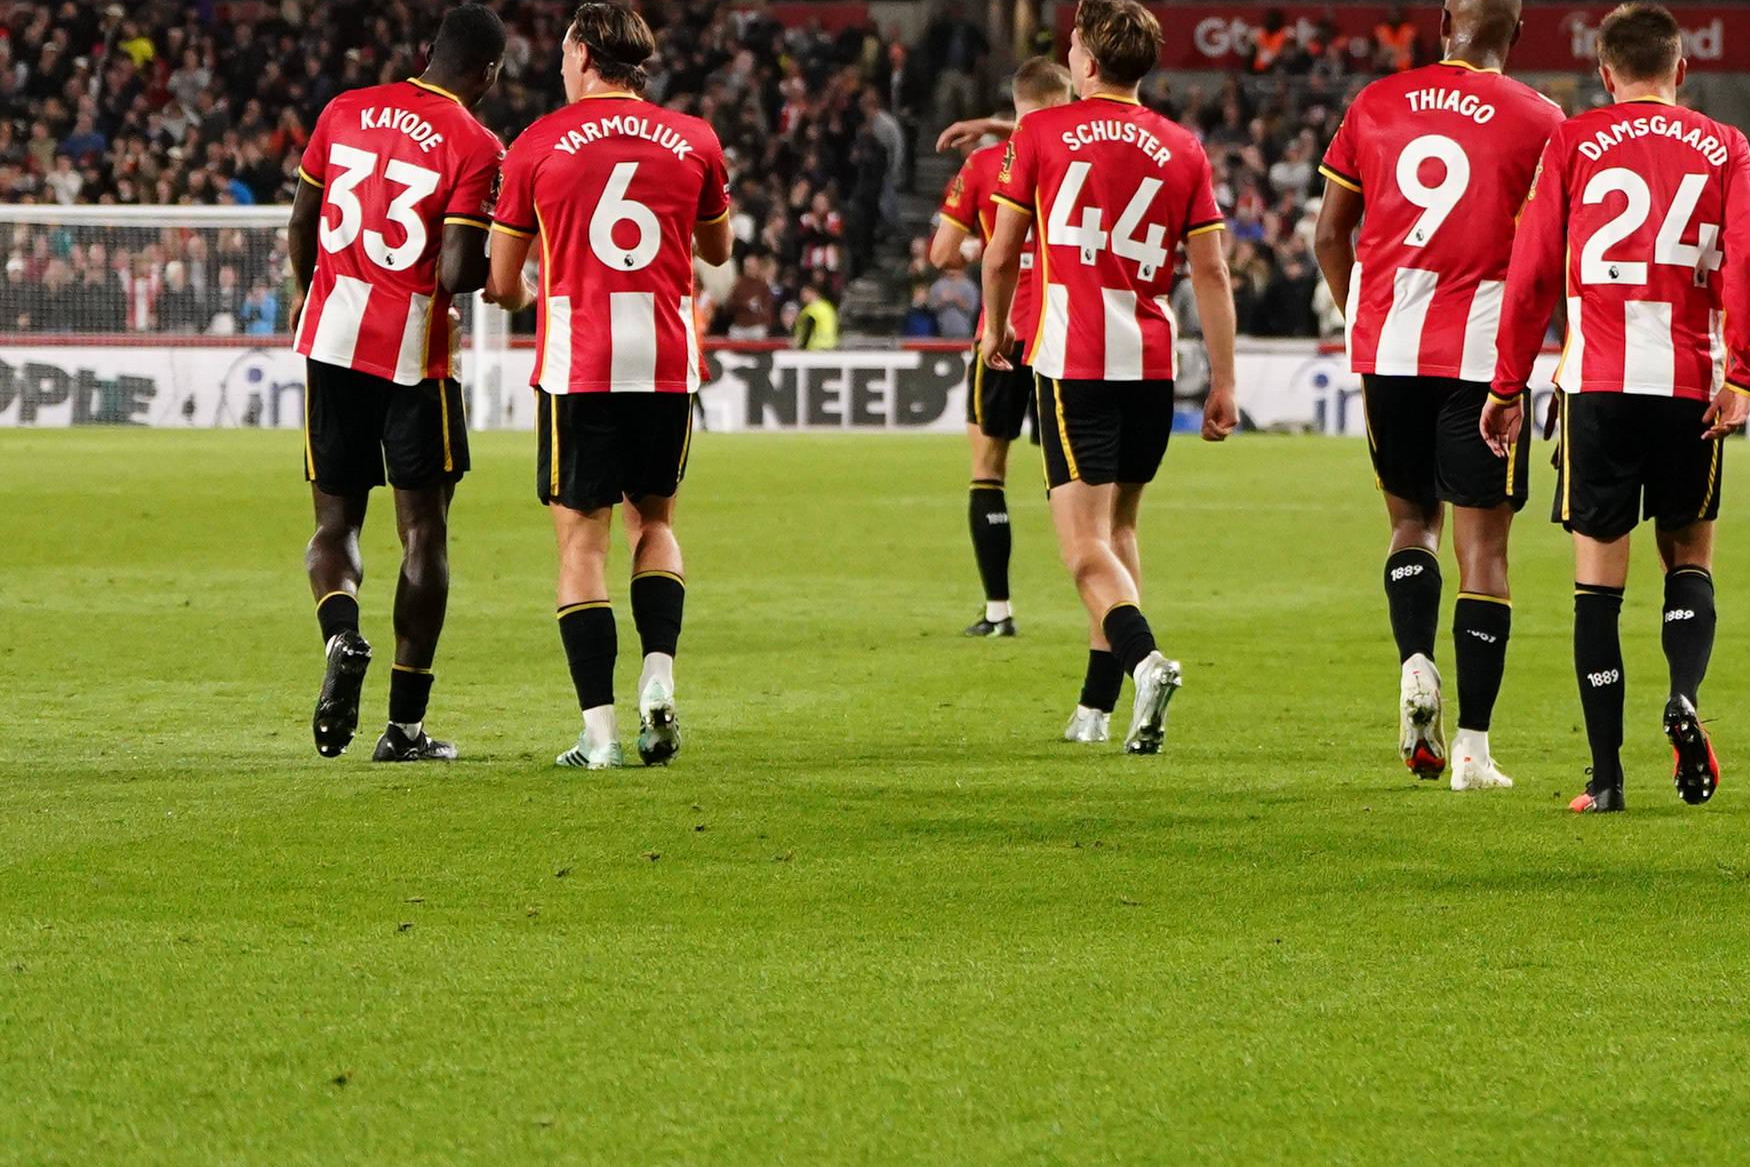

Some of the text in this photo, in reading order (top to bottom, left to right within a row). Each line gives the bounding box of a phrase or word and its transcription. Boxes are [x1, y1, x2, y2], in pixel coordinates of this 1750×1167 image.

[360, 106, 444, 153] KAYODE
[1406, 88, 1496, 124] THIAGO
[553, 115, 694, 162] YARMOLIUK
[1062, 120, 1172, 169] SCHUSTER
[1578, 115, 1728, 167] DAMSGAARD
[319, 143, 441, 272] 33
[1395, 134, 1471, 248] 9
[589, 161, 661, 272] 6
[1047, 161, 1172, 283] 44
[1581, 166, 1724, 288] 24
[1390, 563, 1424, 582] 1889
[1586, 668, 1619, 688] 1889
